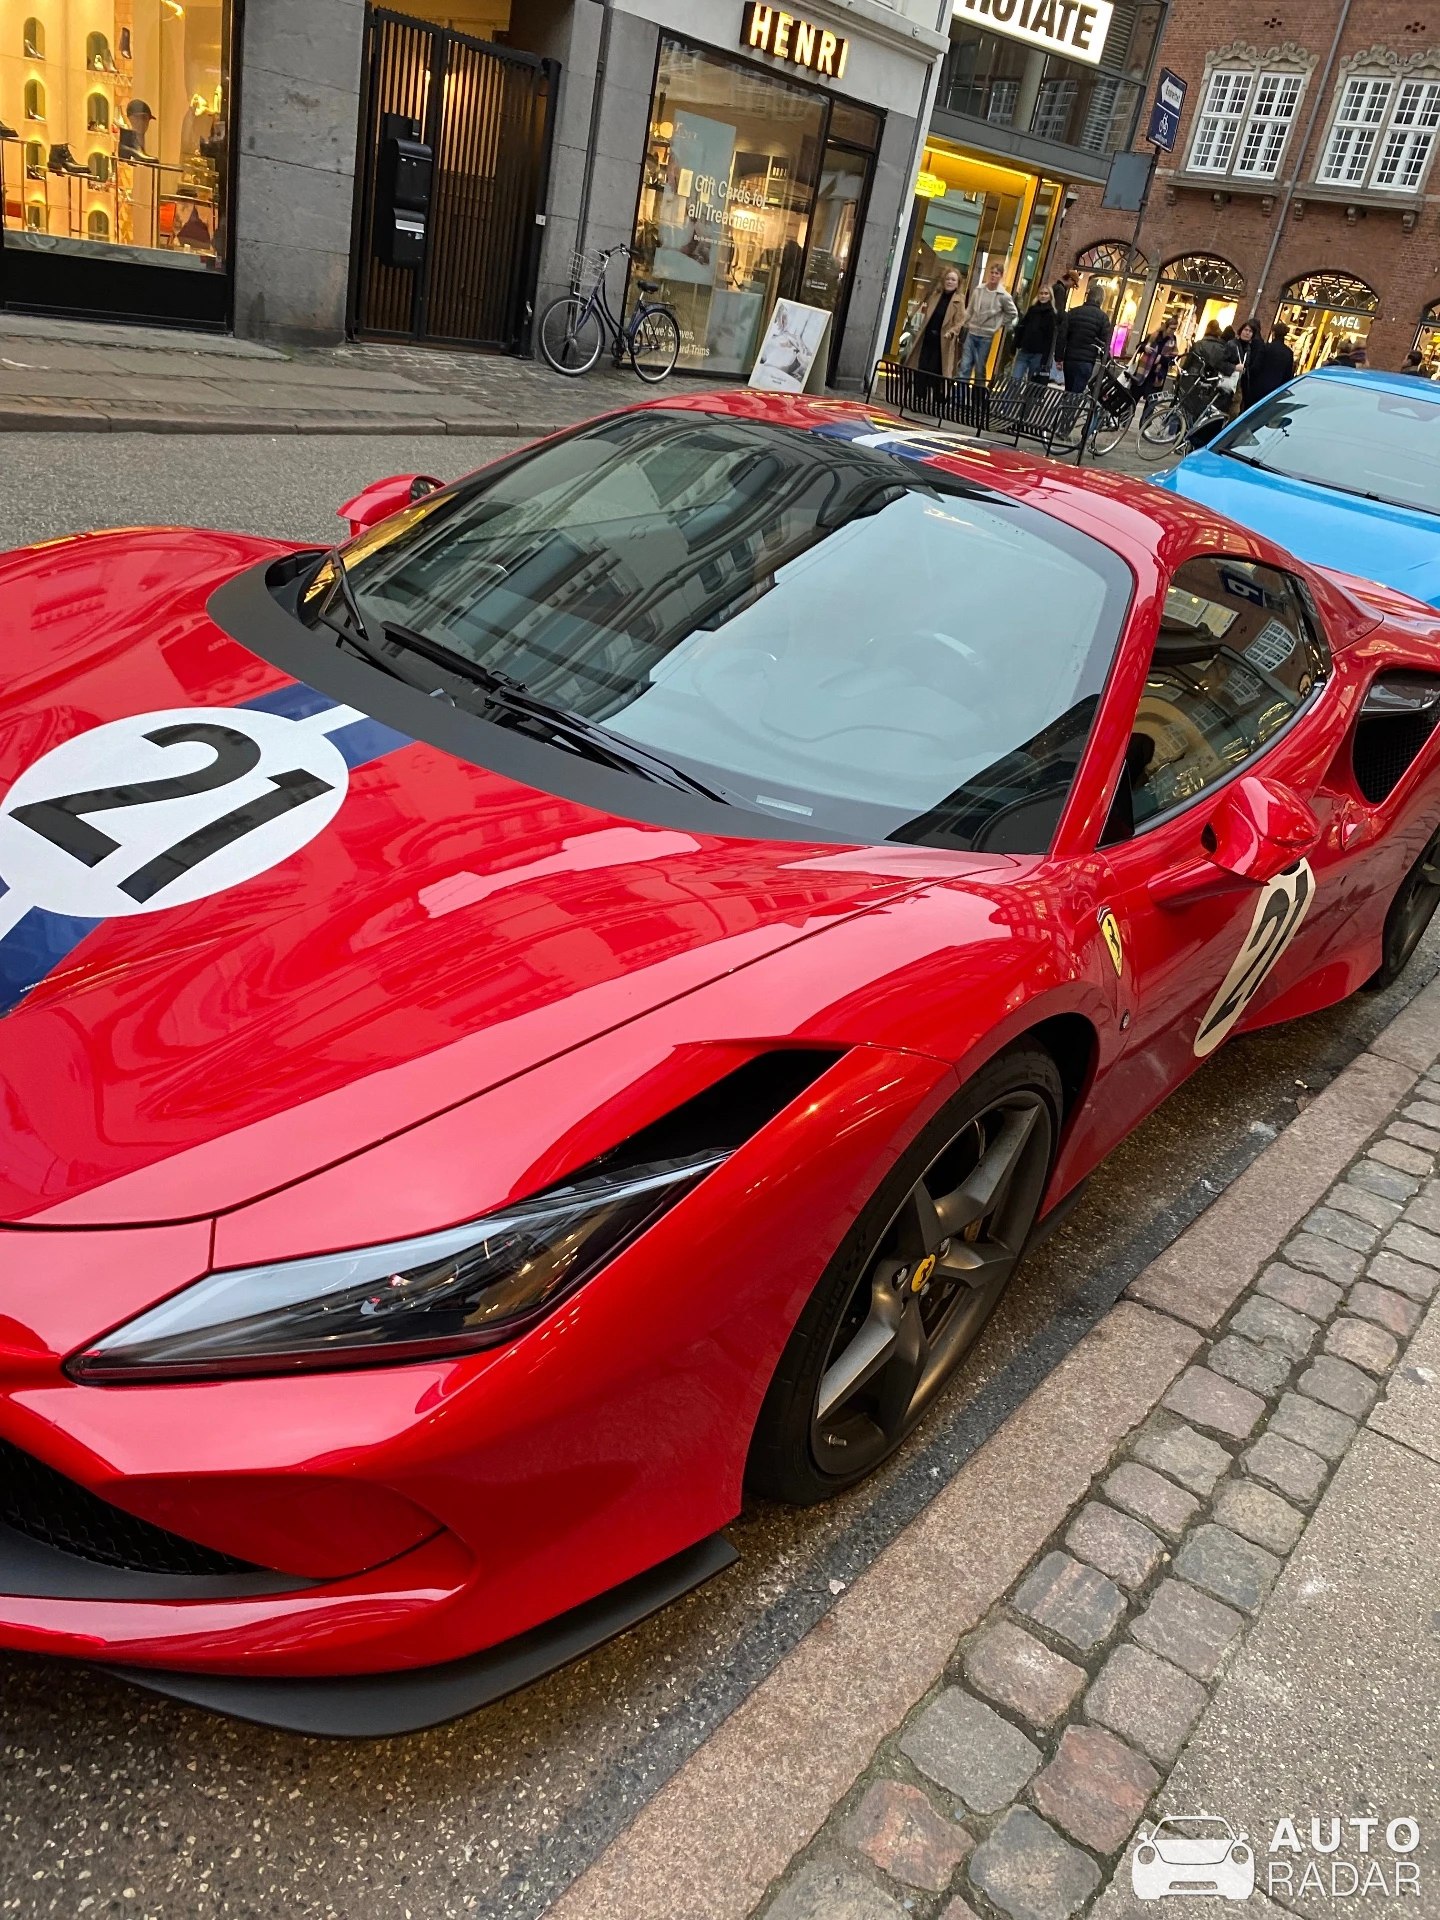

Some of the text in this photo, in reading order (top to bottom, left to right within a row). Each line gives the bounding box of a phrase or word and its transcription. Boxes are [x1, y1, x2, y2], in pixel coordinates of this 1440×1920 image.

[749, 2, 849, 80] HENRI
[695, 174, 768, 208] Gift Cards for
[688, 200, 703, 219] all
[1330, 315, 1360, 330] AXEL
[691, 344, 710, 356] Trims
[7, 722, 336, 905] 21
[1197, 868, 1309, 1042] 21
